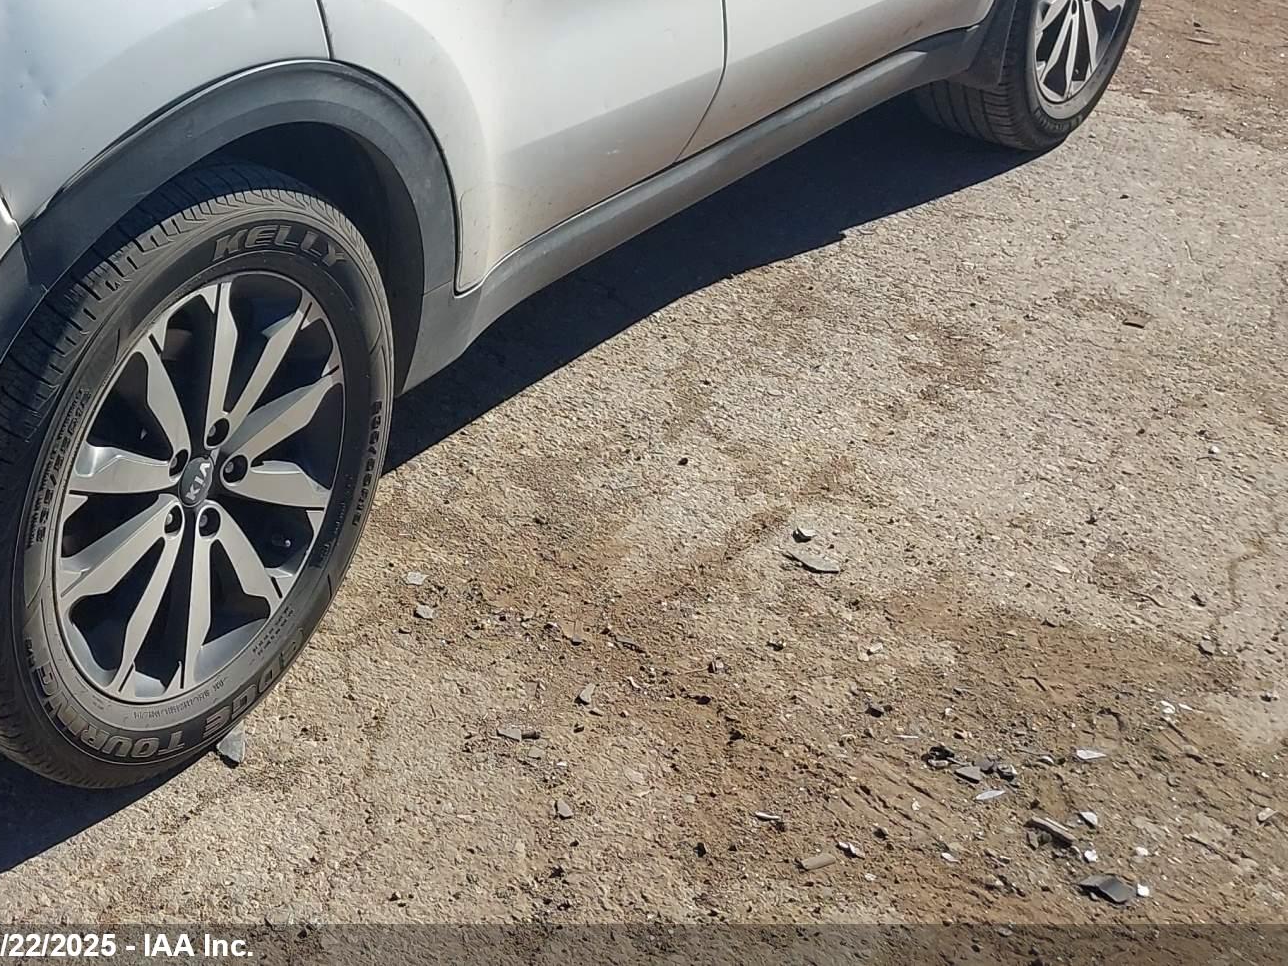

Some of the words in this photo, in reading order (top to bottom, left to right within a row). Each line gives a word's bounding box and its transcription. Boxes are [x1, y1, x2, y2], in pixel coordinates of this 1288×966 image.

[212, 224, 346, 268] KELLY
[185, 462, 211, 501] KIA
[34, 660, 186, 759] TOURING
